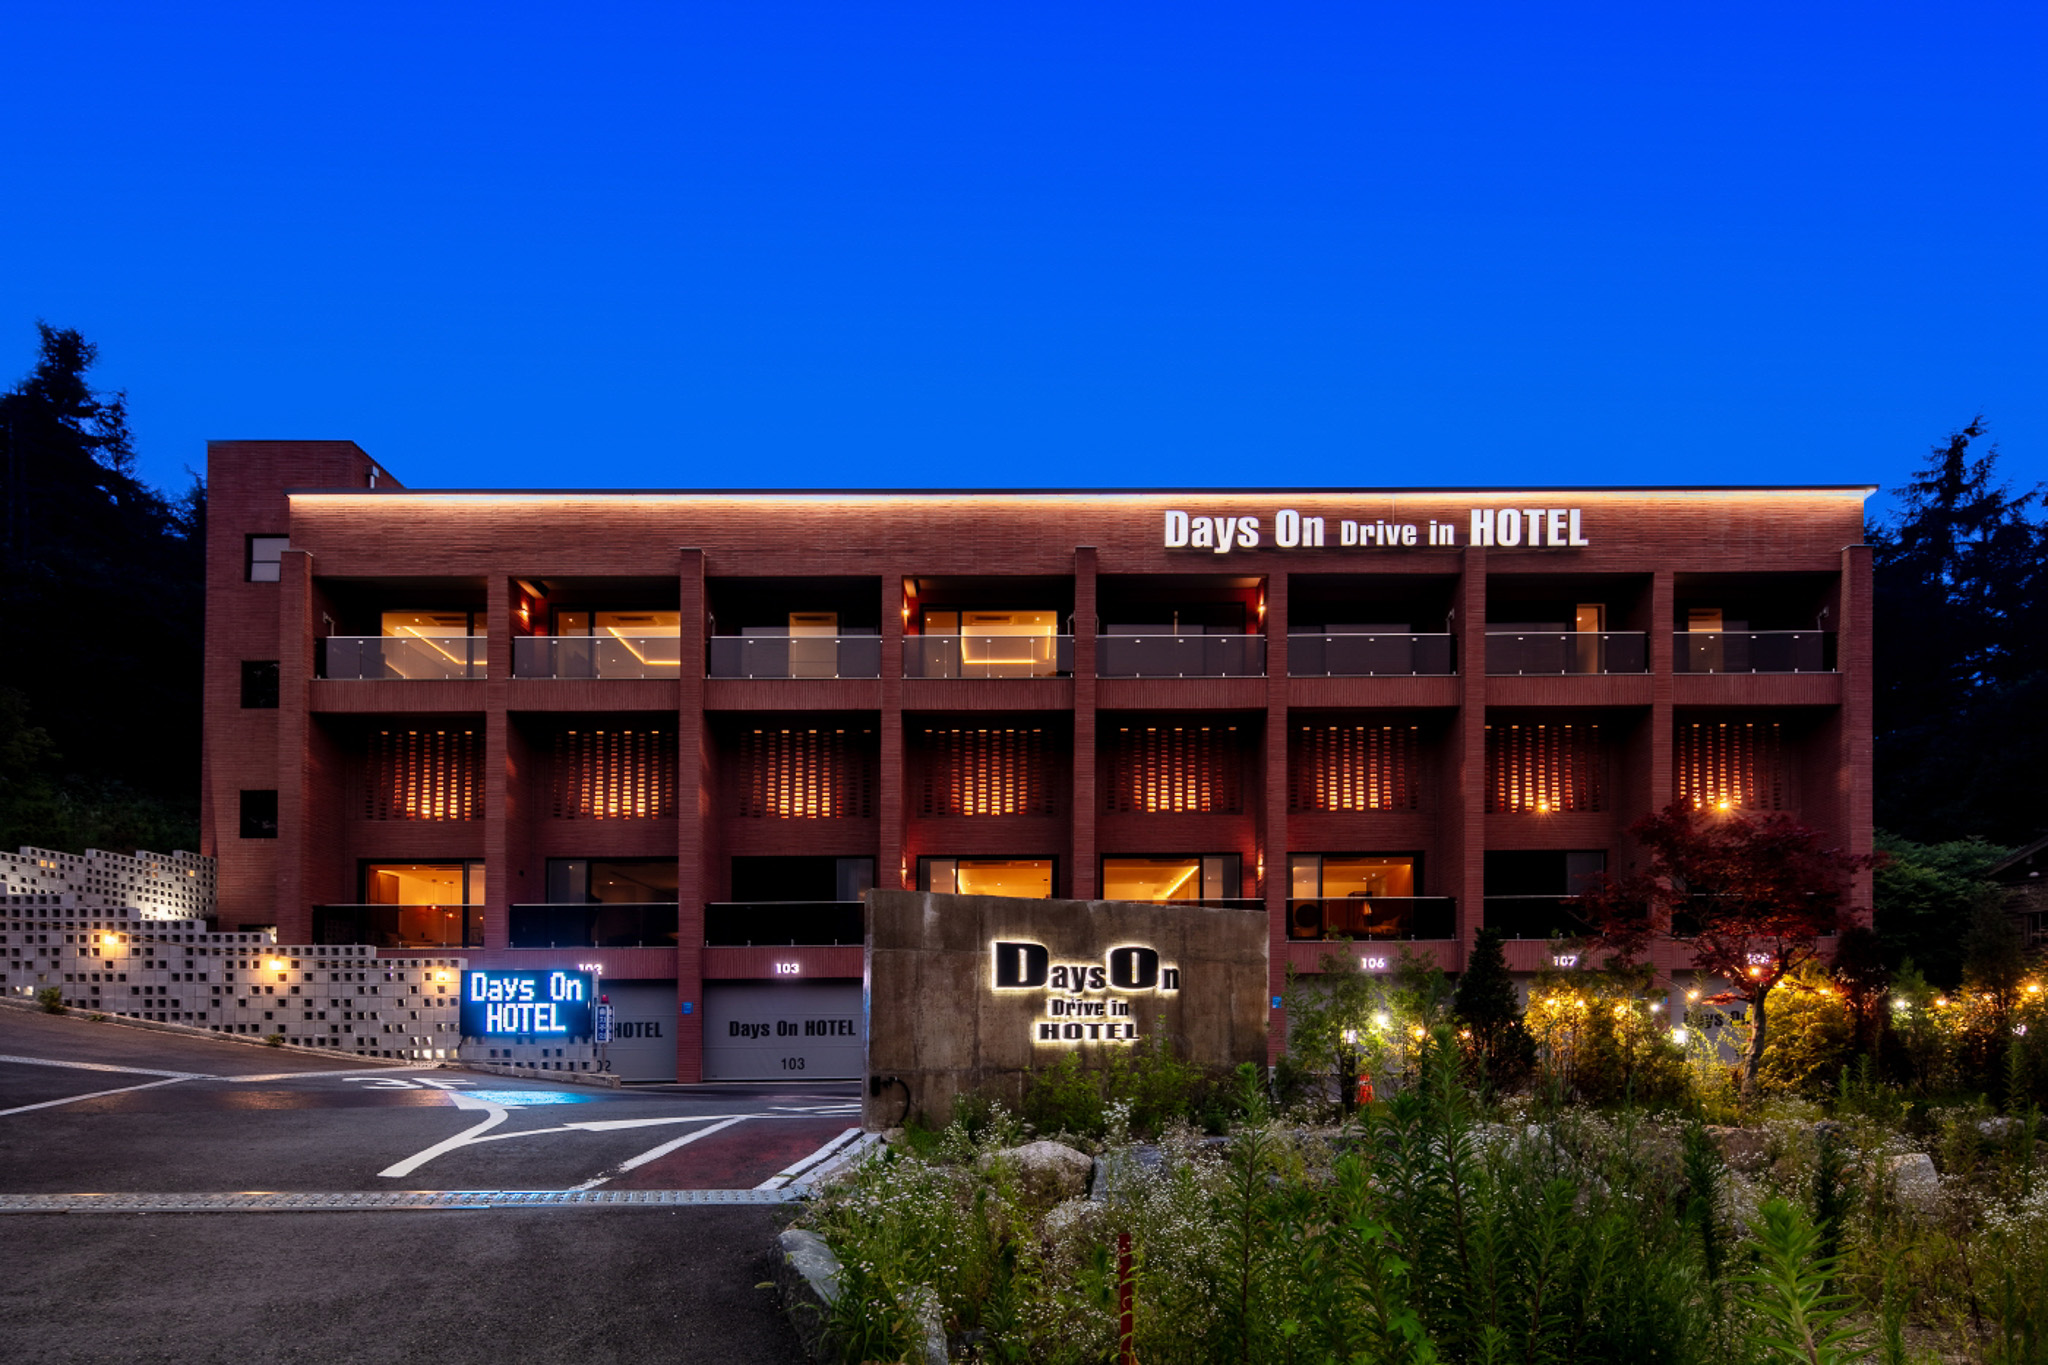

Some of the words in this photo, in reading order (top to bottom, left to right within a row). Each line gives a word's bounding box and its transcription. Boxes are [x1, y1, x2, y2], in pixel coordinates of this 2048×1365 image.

[1165, 509, 1260, 553] Days
[1275, 509, 1325, 548] On
[1340, 520, 1417, 546] Drive
[1429, 520, 1455, 546] in
[1470, 508, 1589, 547] HOTEL
[775, 963, 800, 974] 103
[995, 941, 1108, 993] Days
[1361, 957, 1386, 969] 106
[1553, 955, 1577, 967] 107
[470, 972, 535, 1002] Days
[550, 971, 583, 1001] On
[1051, 999, 1105, 1016] Drive
[1110, 999, 1129, 1016] in
[485, 1002, 567, 1033] HOTEL
[614, 1021, 664, 1038] HOTEL
[729, 1020, 771, 1039] Days
[776, 1020, 798, 1036] On
[804, 1019, 857, 1036] HOTEL
[1038, 1022, 1140, 1040] HOTEL
[780, 1057, 806, 1070] 103
